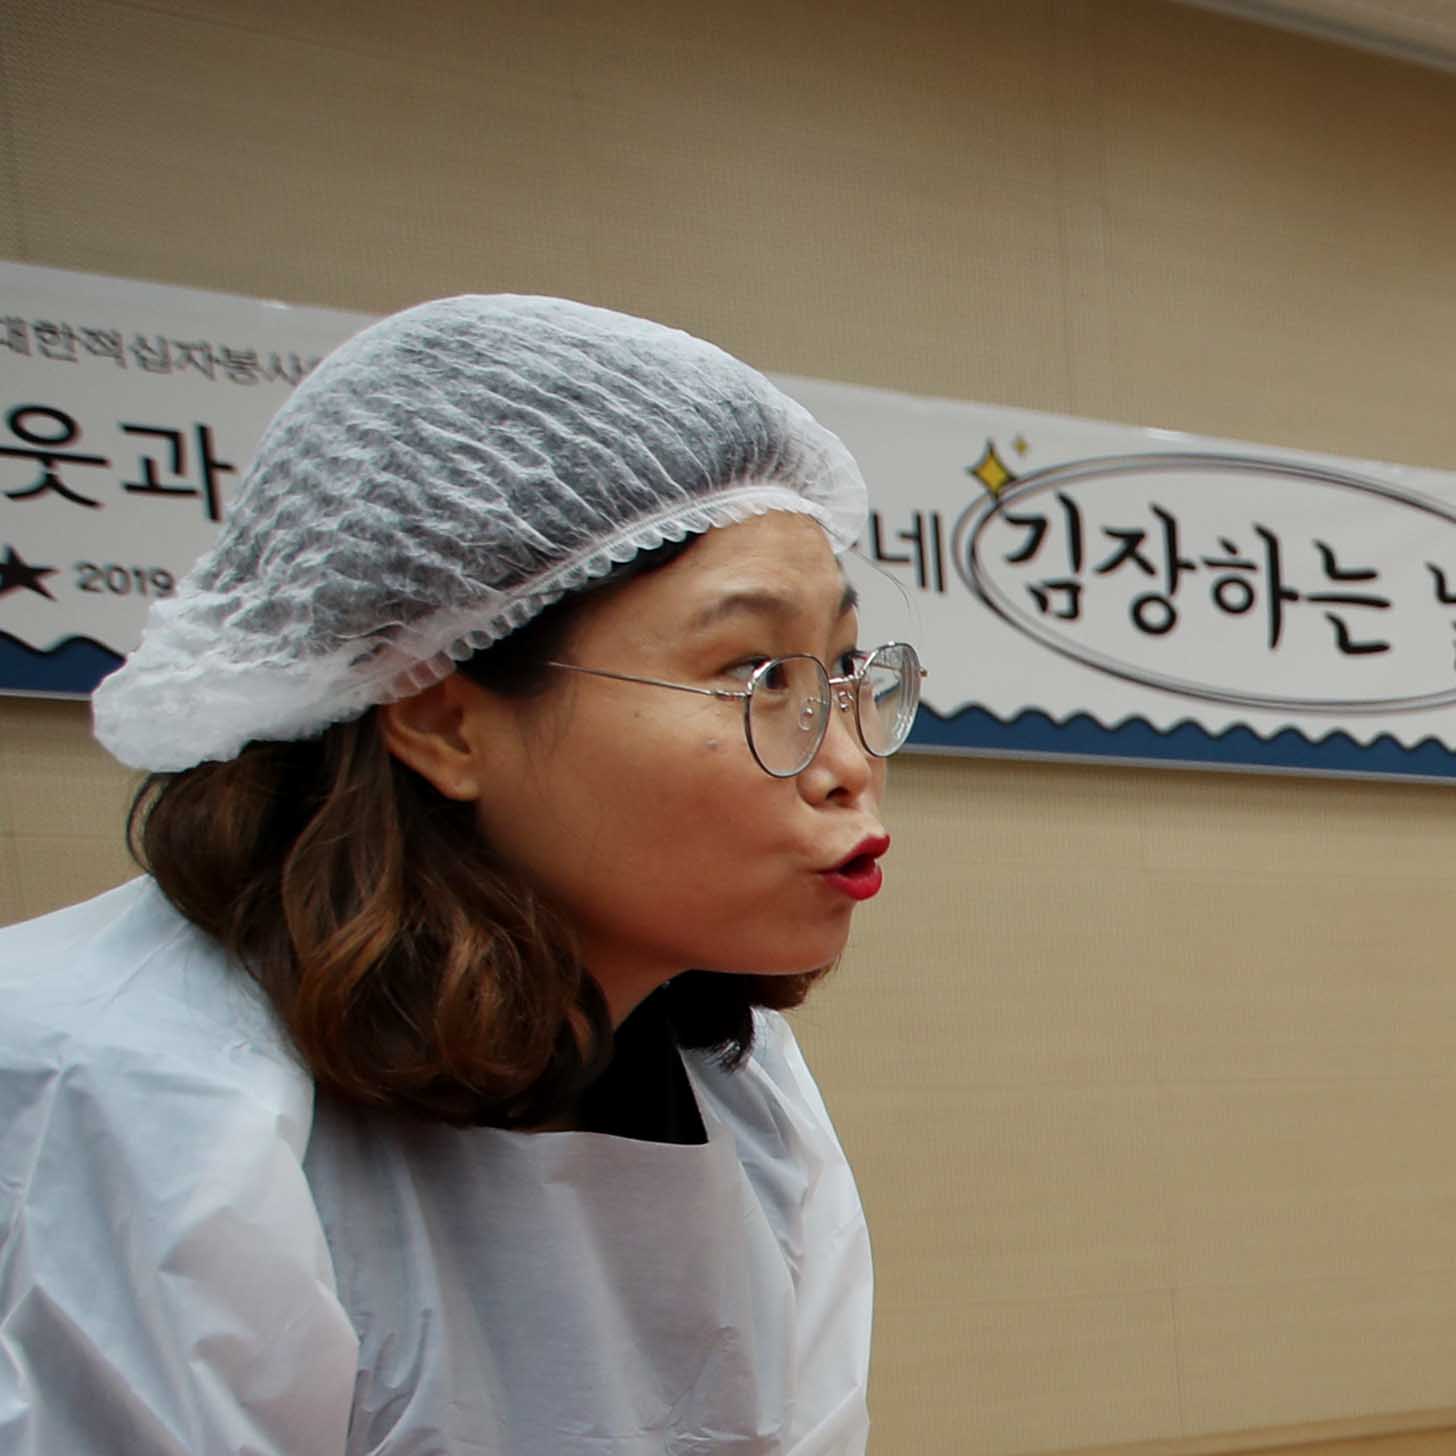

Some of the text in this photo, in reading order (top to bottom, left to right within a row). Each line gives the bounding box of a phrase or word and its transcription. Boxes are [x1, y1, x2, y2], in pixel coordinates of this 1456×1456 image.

[0, 316, 325, 387] 대한적십자봉사
[76, 560, 177, 597] 2019
[1001, 492, 1392, 655] 김장하는
